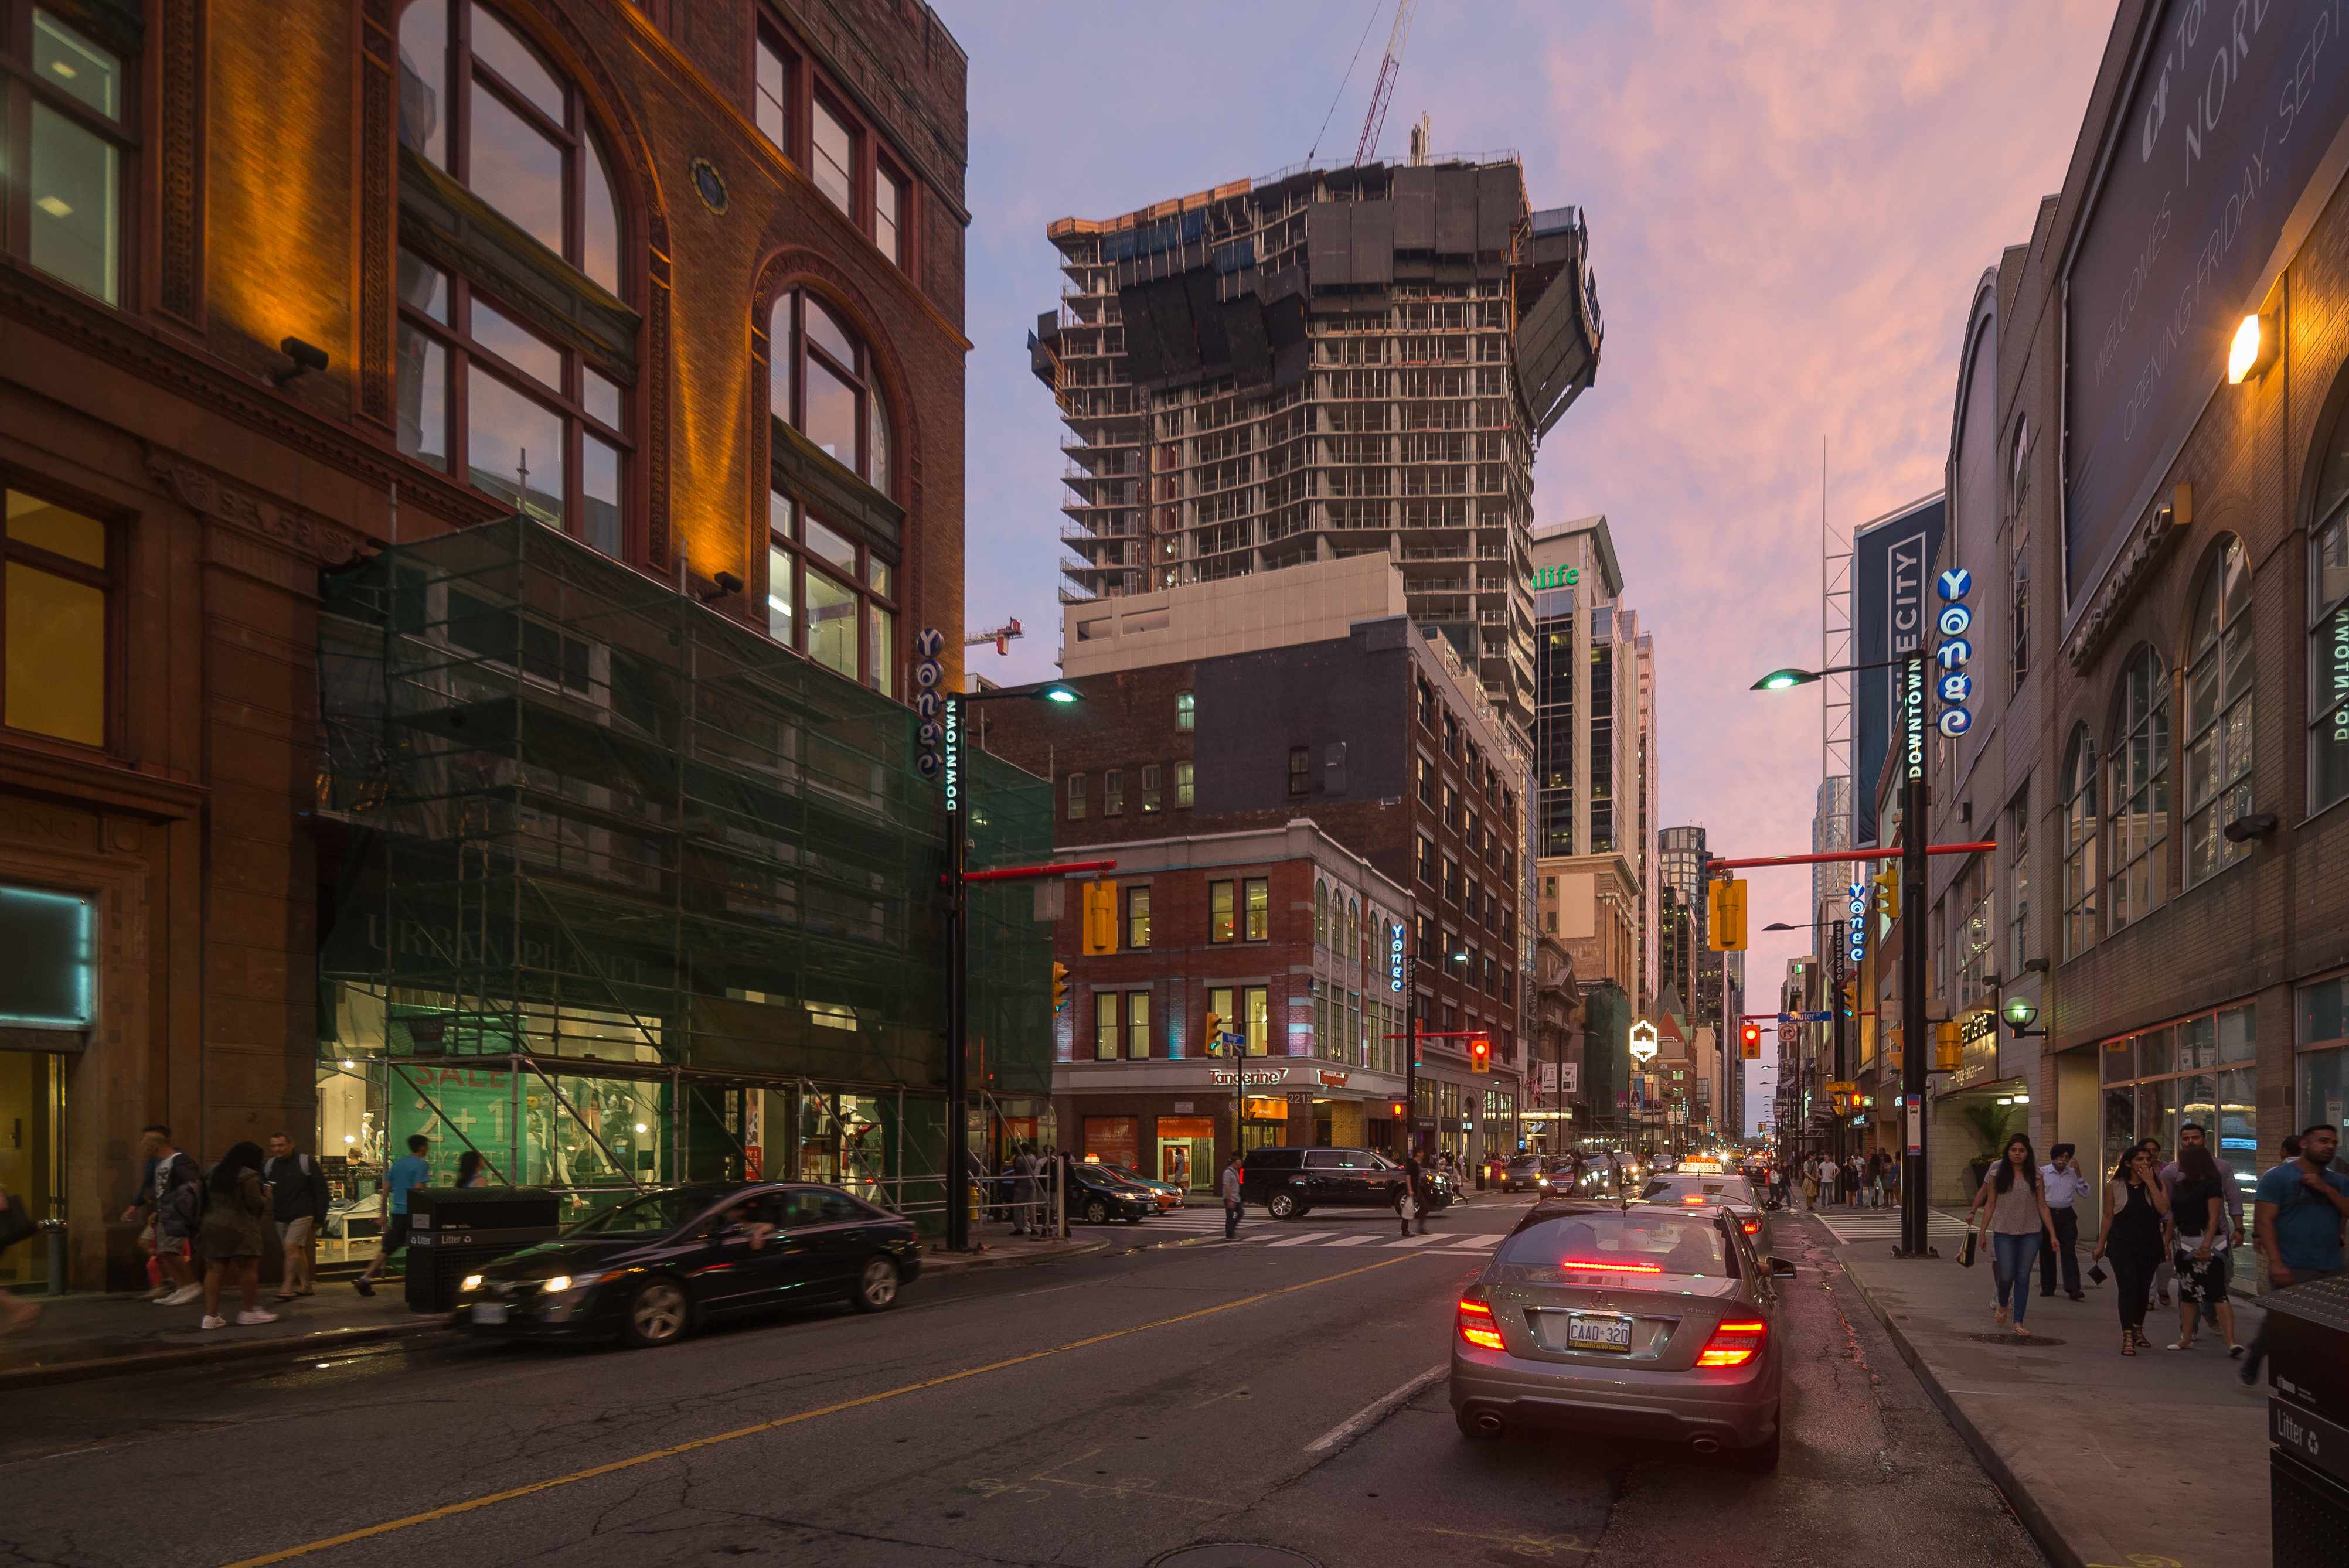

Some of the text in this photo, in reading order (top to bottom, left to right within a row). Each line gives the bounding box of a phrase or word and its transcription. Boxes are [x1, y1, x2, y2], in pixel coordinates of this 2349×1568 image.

[2095, 190, 2171, 387] WELCOMES
[2125, 286, 2191, 442] OPENING
[1938, 568, 1971, 738] Yonge
[918, 629, 942, 779] Yonge
[1908, 658, 1922, 779] DOWNTOWN
[945, 700, 956, 811] DOWNTOWN
[1850, 883, 1865, 961] Yonge
[1391, 925, 1404, 992] Yonge
[1790, 1012, 1816, 1021] Shuter
[414, 1065, 506, 1088] SALE
[1208, 1069, 1281, 1087] Tangerine
[1288, 1094, 1305, 1104] 221
[417, 1235, 431, 1245] Litter
[441, 1235, 462, 1245] Litter
[1570, 1324, 1628, 1344] CAAD 320
[2277, 1408, 2303, 1446] Litter
